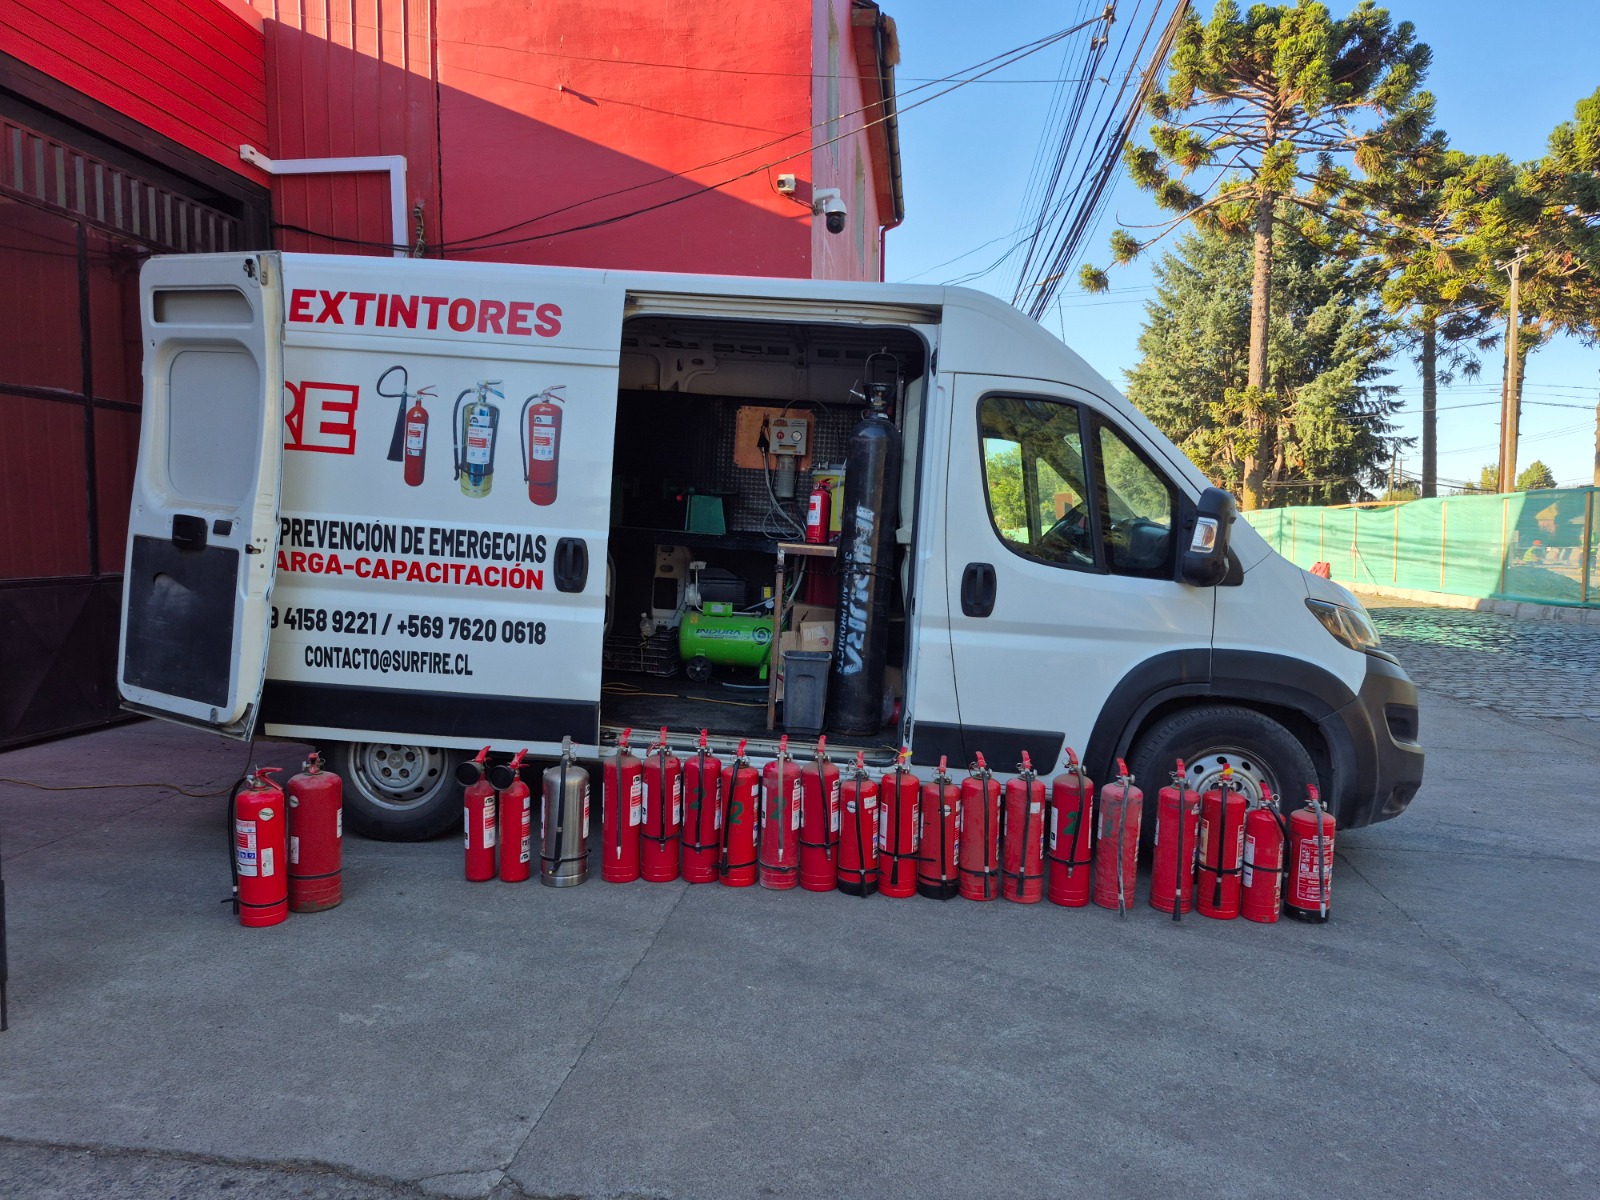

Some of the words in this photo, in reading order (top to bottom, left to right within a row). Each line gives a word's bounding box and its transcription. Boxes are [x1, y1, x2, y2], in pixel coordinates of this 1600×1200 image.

[289, 288, 562, 338] EXTINTORES
[279, 517, 396, 554] PREVENCIÓN
[401, 525, 425, 555] DE
[429, 527, 547, 564] EMERGECIAS
[283, 607, 327, 632] 4158
[331, 610, 377, 636] 9221
[397, 614, 444, 639] +569
[448, 617, 497, 642] 7620
[501, 620, 546, 645] 0618
[695, 628, 741, 636] INDURA
[304, 645, 473, 676] CONTACTO@SURFIRE.CL
[730, 801, 744, 825] 2
